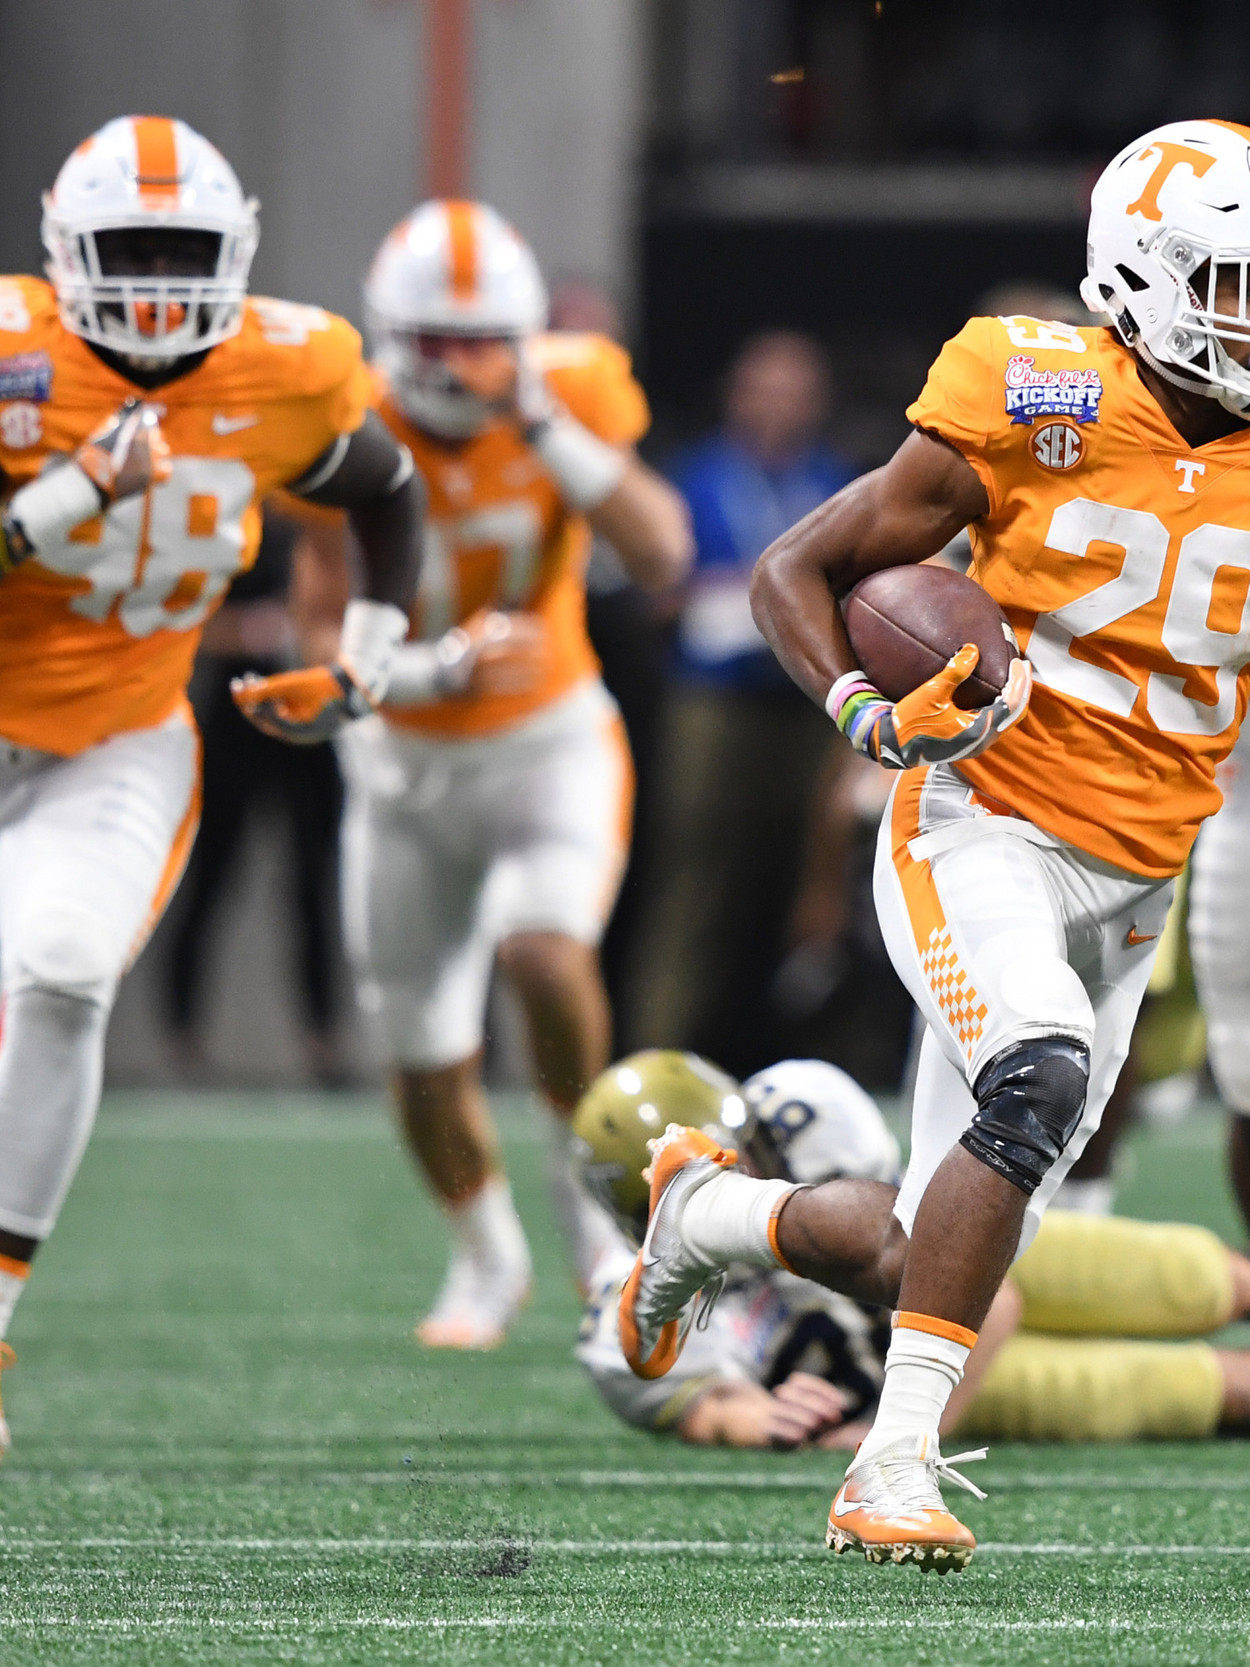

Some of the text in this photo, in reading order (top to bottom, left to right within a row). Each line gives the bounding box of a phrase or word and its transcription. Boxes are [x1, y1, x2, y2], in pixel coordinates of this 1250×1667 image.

[1126, 141, 1218, 222] T
[1006, 388, 1102, 411] KICKOFF
[1024, 404, 1083, 415] GAME
[1034, 425, 1081, 469] SEC
[1174, 459, 1205, 493] T
[30, 455, 256, 639] 48
